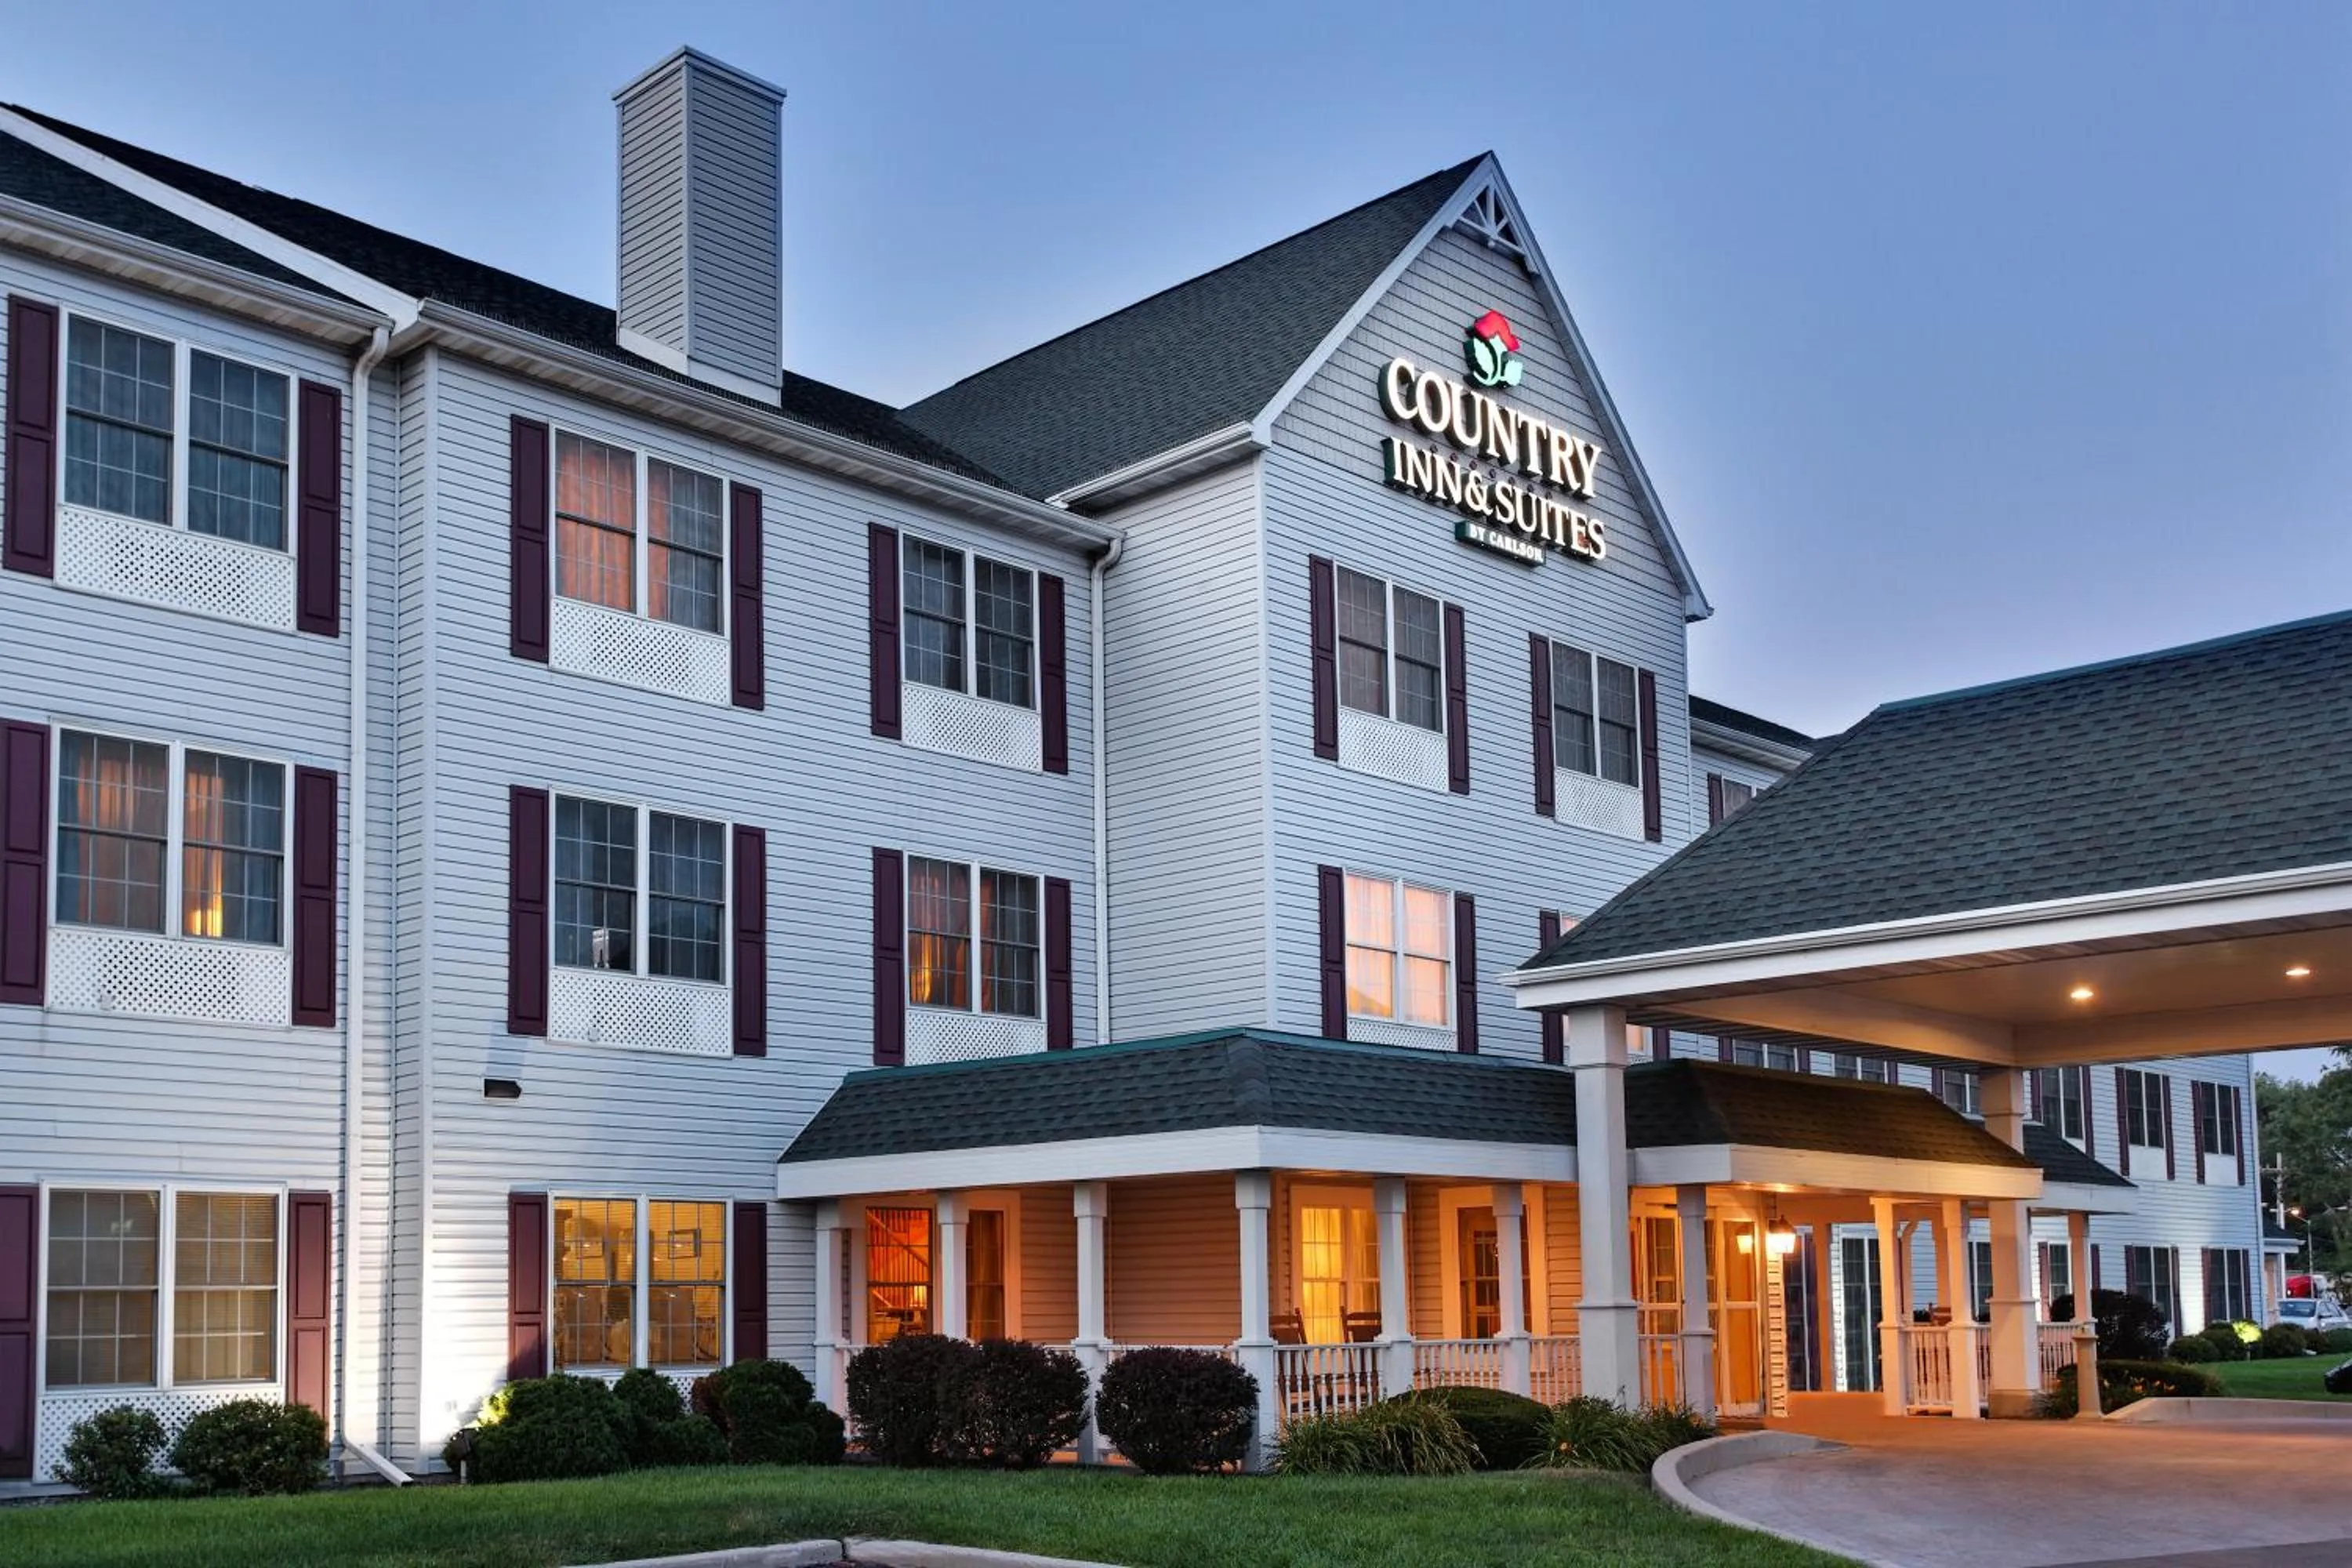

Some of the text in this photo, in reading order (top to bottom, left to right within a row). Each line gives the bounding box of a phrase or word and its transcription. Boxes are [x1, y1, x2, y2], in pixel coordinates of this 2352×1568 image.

[1386, 357, 1602, 499] COUNTRY
[1469, 522, 1544, 563] BY CARLSON
